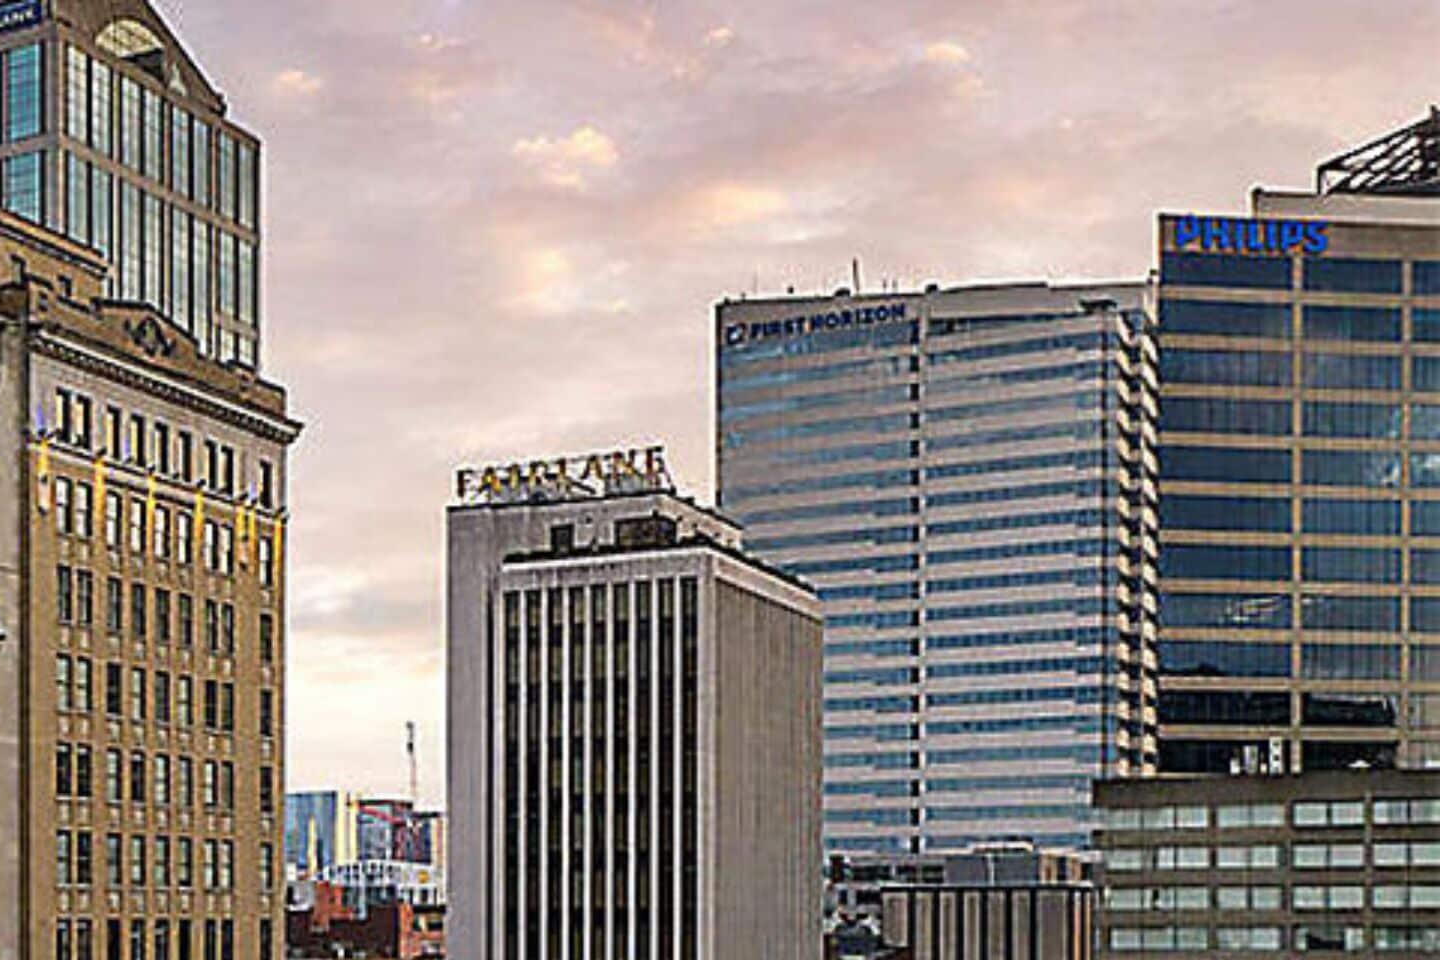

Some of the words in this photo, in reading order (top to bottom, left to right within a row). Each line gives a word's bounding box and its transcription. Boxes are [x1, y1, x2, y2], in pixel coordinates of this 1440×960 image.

[1173, 216, 1331, 251] PHILIPS
[751, 316, 806, 338] FIRST
[811, 303, 906, 331] HORIZON
